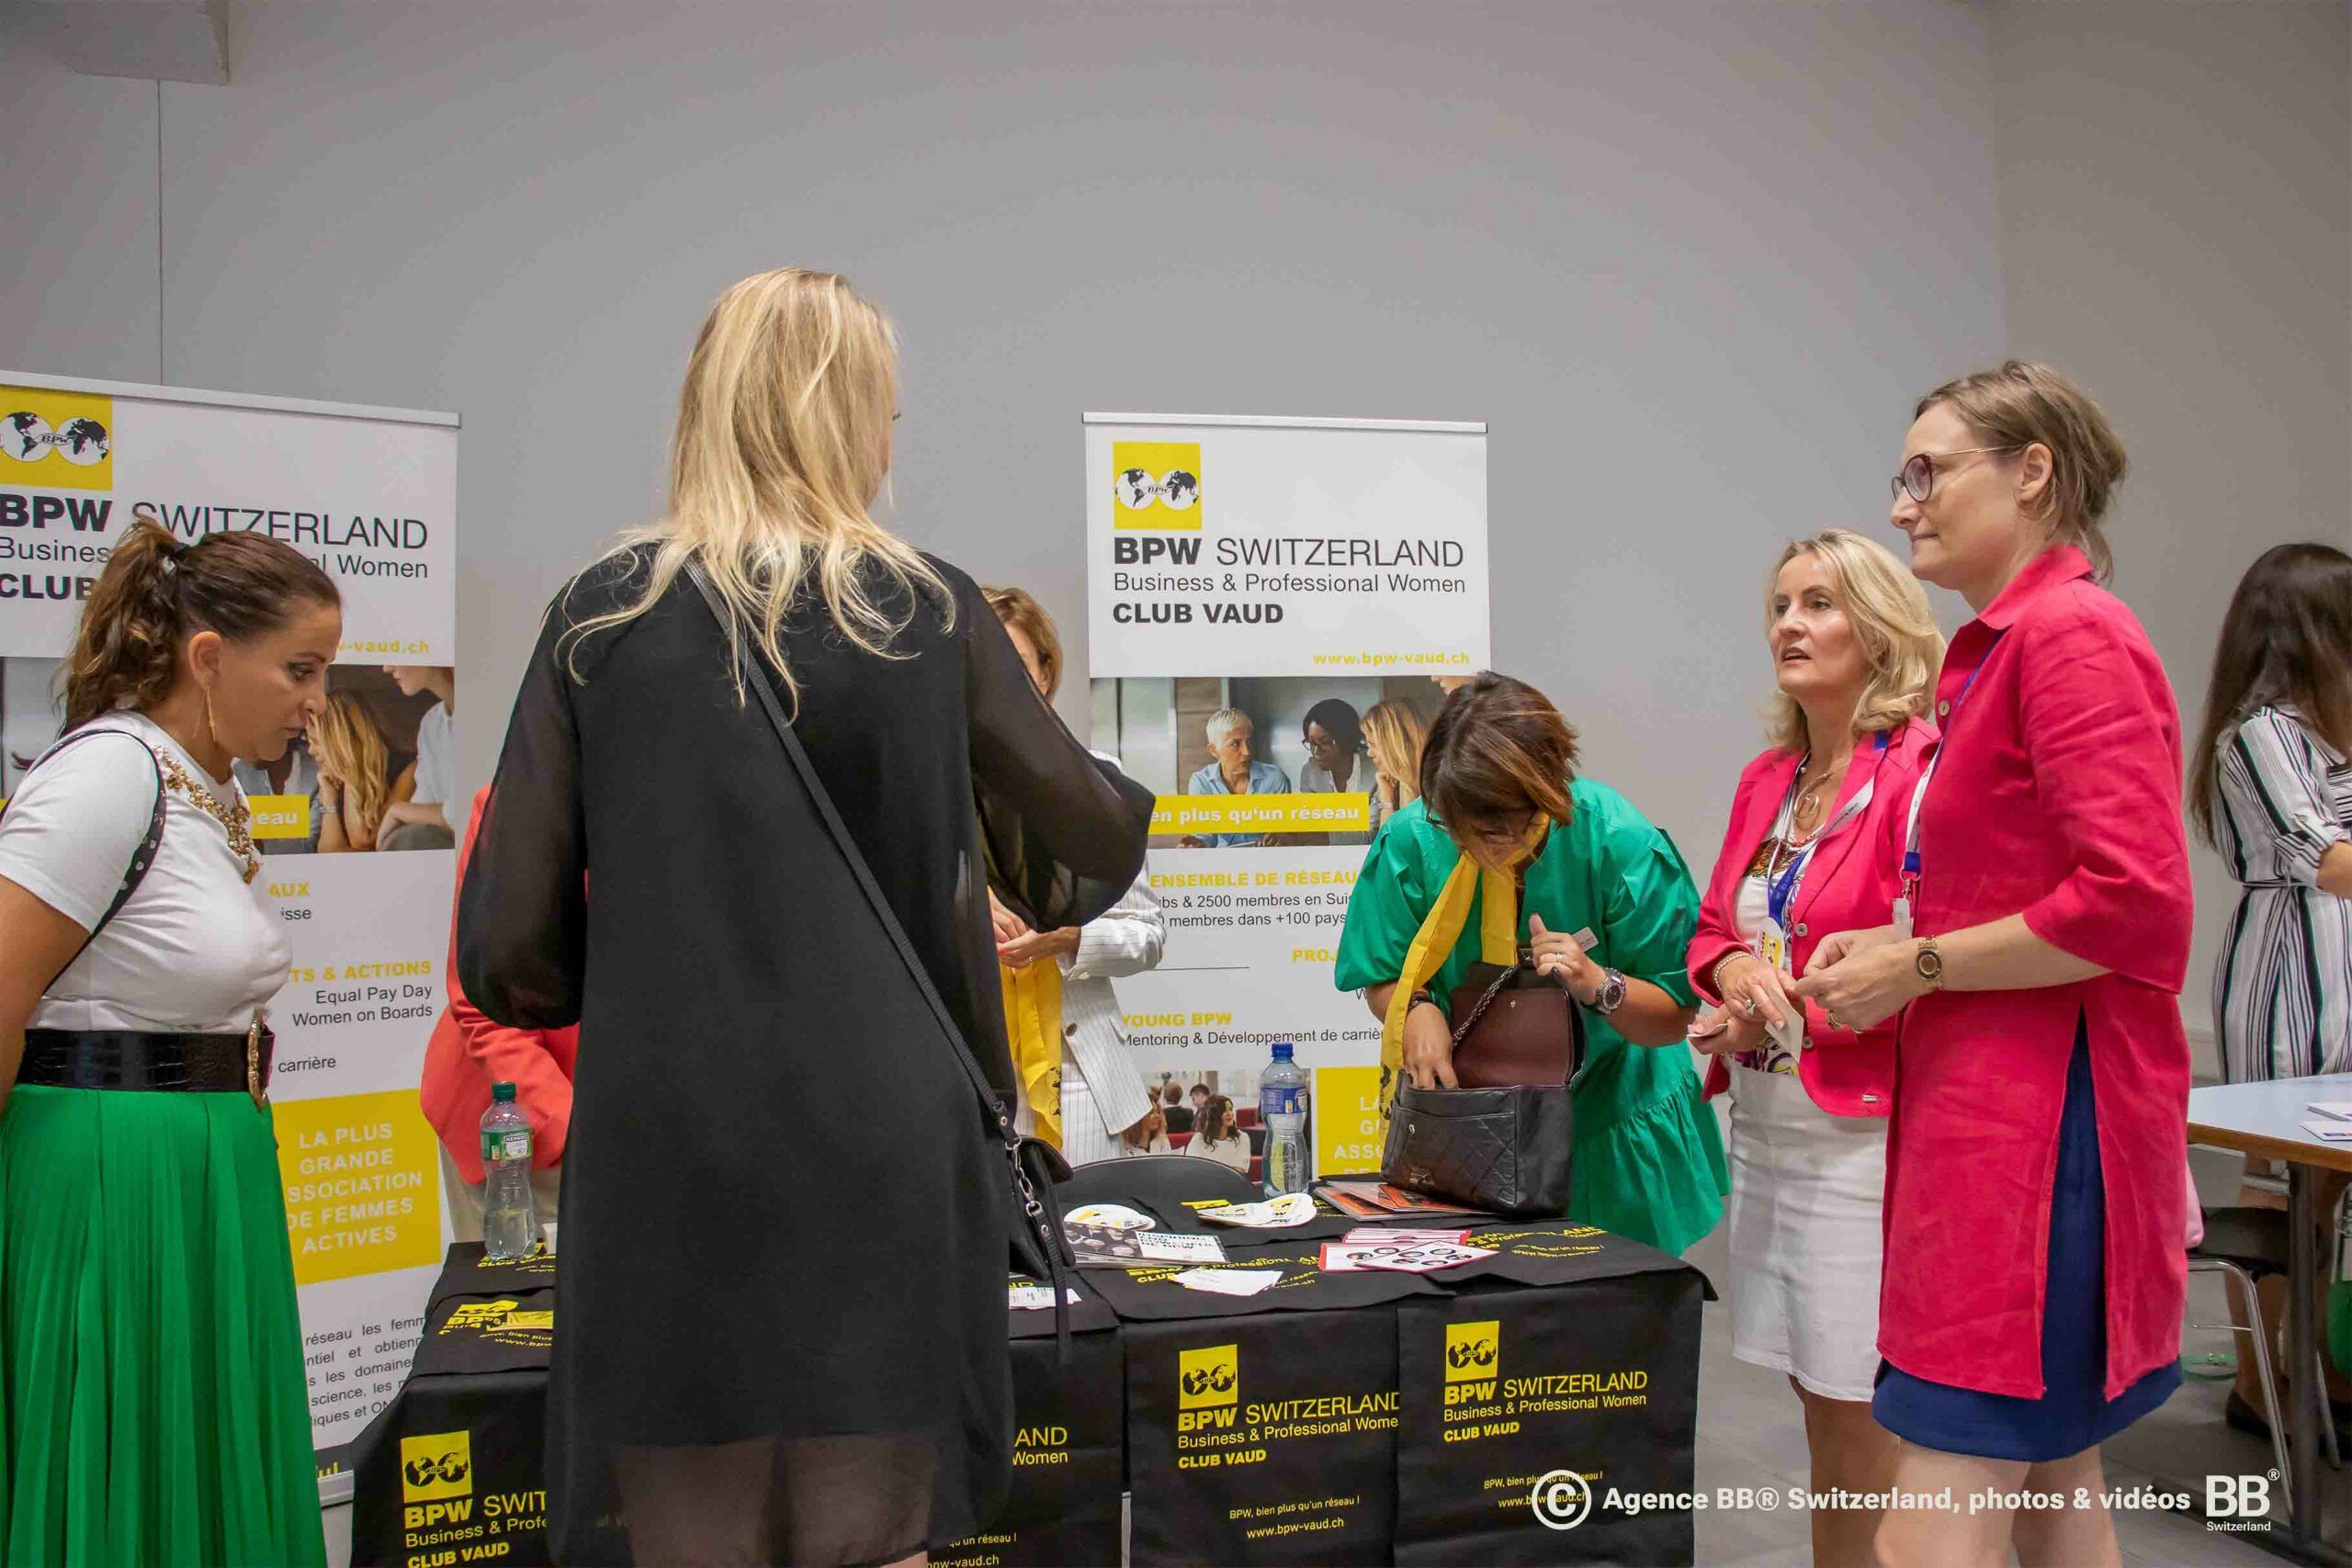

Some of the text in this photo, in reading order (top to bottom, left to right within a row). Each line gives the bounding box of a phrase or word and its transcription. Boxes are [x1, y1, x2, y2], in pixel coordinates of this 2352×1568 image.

[0, 493, 113, 532] BPW
[0, 536, 110, 562] Busines
[337, 554, 428, 579] Women
[1114, 537, 1464, 567] BPW SWITZERLAND
[1114, 572, 1466, 593] Business & Professional Women
[1113, 603, 1283, 625] CLUB VAUD
[1313, 651, 1470, 668] www.bpw-vaud.ch
[1179, 807, 1222, 825] plus
[1228, 807, 1283, 825] qu'un
[1290, 805, 1360, 820] réseau
[1149, 869, 1357, 888] ENSEMBLE DE RÉSEAU
[1182, 895, 1193, 908] &
[1197, 895, 1231, 908] 2500
[1236, 894, 1300, 907] membres
[1305, 895, 1321, 905] en
[1170, 914, 1234, 927] membres
[1238, 913, 1272, 926] dans
[1276, 912, 1310, 925] +100
[1315, 914, 1347, 927] pays
[322, 967, 336, 981] &
[345, 960, 432, 980] ACTIONS
[315, 983, 433, 1006] Equal Pay Day
[292, 1004, 433, 1027] Women on Boards
[1122, 1011, 1234, 1028] YOUNG BPW
[1193, 1032, 1203, 1044] &
[1208, 1029, 1317, 1046] Développement
[1320, 1028, 1336, 1042] de
[277, 1056, 337, 1073] carrière
[299, 1122, 393, 1148] LA PLUS
[300, 1148, 394, 1175] GRANDE
[288, 1170, 423, 1203] SSOCIATION
[322, 1197, 413, 1224] FEMMES
[301, 1225, 397, 1254] ACTIVES
[305, 1329, 353, 1347] réseau
[362, 1325, 382, 1337] les
[348, 1347, 362, 1359] et
[325, 1371, 345, 1383] les
[355, 1358, 412, 1378] domaine
[311, 1387, 368, 1406] science,
[373, 1381, 392, 1394] les
[1444, 1371, 1648, 1405] BPW SWITZERLAND
[355, 1405, 367, 1417] et
[1178, 1406, 1238, 1432] BPW
[1443, 1394, 1647, 1423] Business & Professional Women
[1178, 1416, 1399, 1450] Business & Professional Wome
[1443, 1421, 1521, 1443] CLUB VAUD
[1012, 1451, 1069, 1466] Women
[1178, 1449, 1267, 1470] CLUB VAUD
[1507, 1474, 1525, 1486] bien
[404, 1498, 473, 1529] BPW
[1229, 1508, 1254, 1520] BPW,
[1256, 1505, 1275, 1517] bien
[1277, 1502, 1296, 1516] plus
[1298, 1499, 1323, 1513] qu'un
[1325, 1496, 1355, 1507] réseau
[406, 1525, 484, 1549] Business
[489, 1520, 502, 1534] &
[978, 1533, 1012, 1545] réseau
[1247, 1517, 1344, 1540] www.bpw-vaud.ch
[408, 1541, 510, 1568] CLUB VAUD
